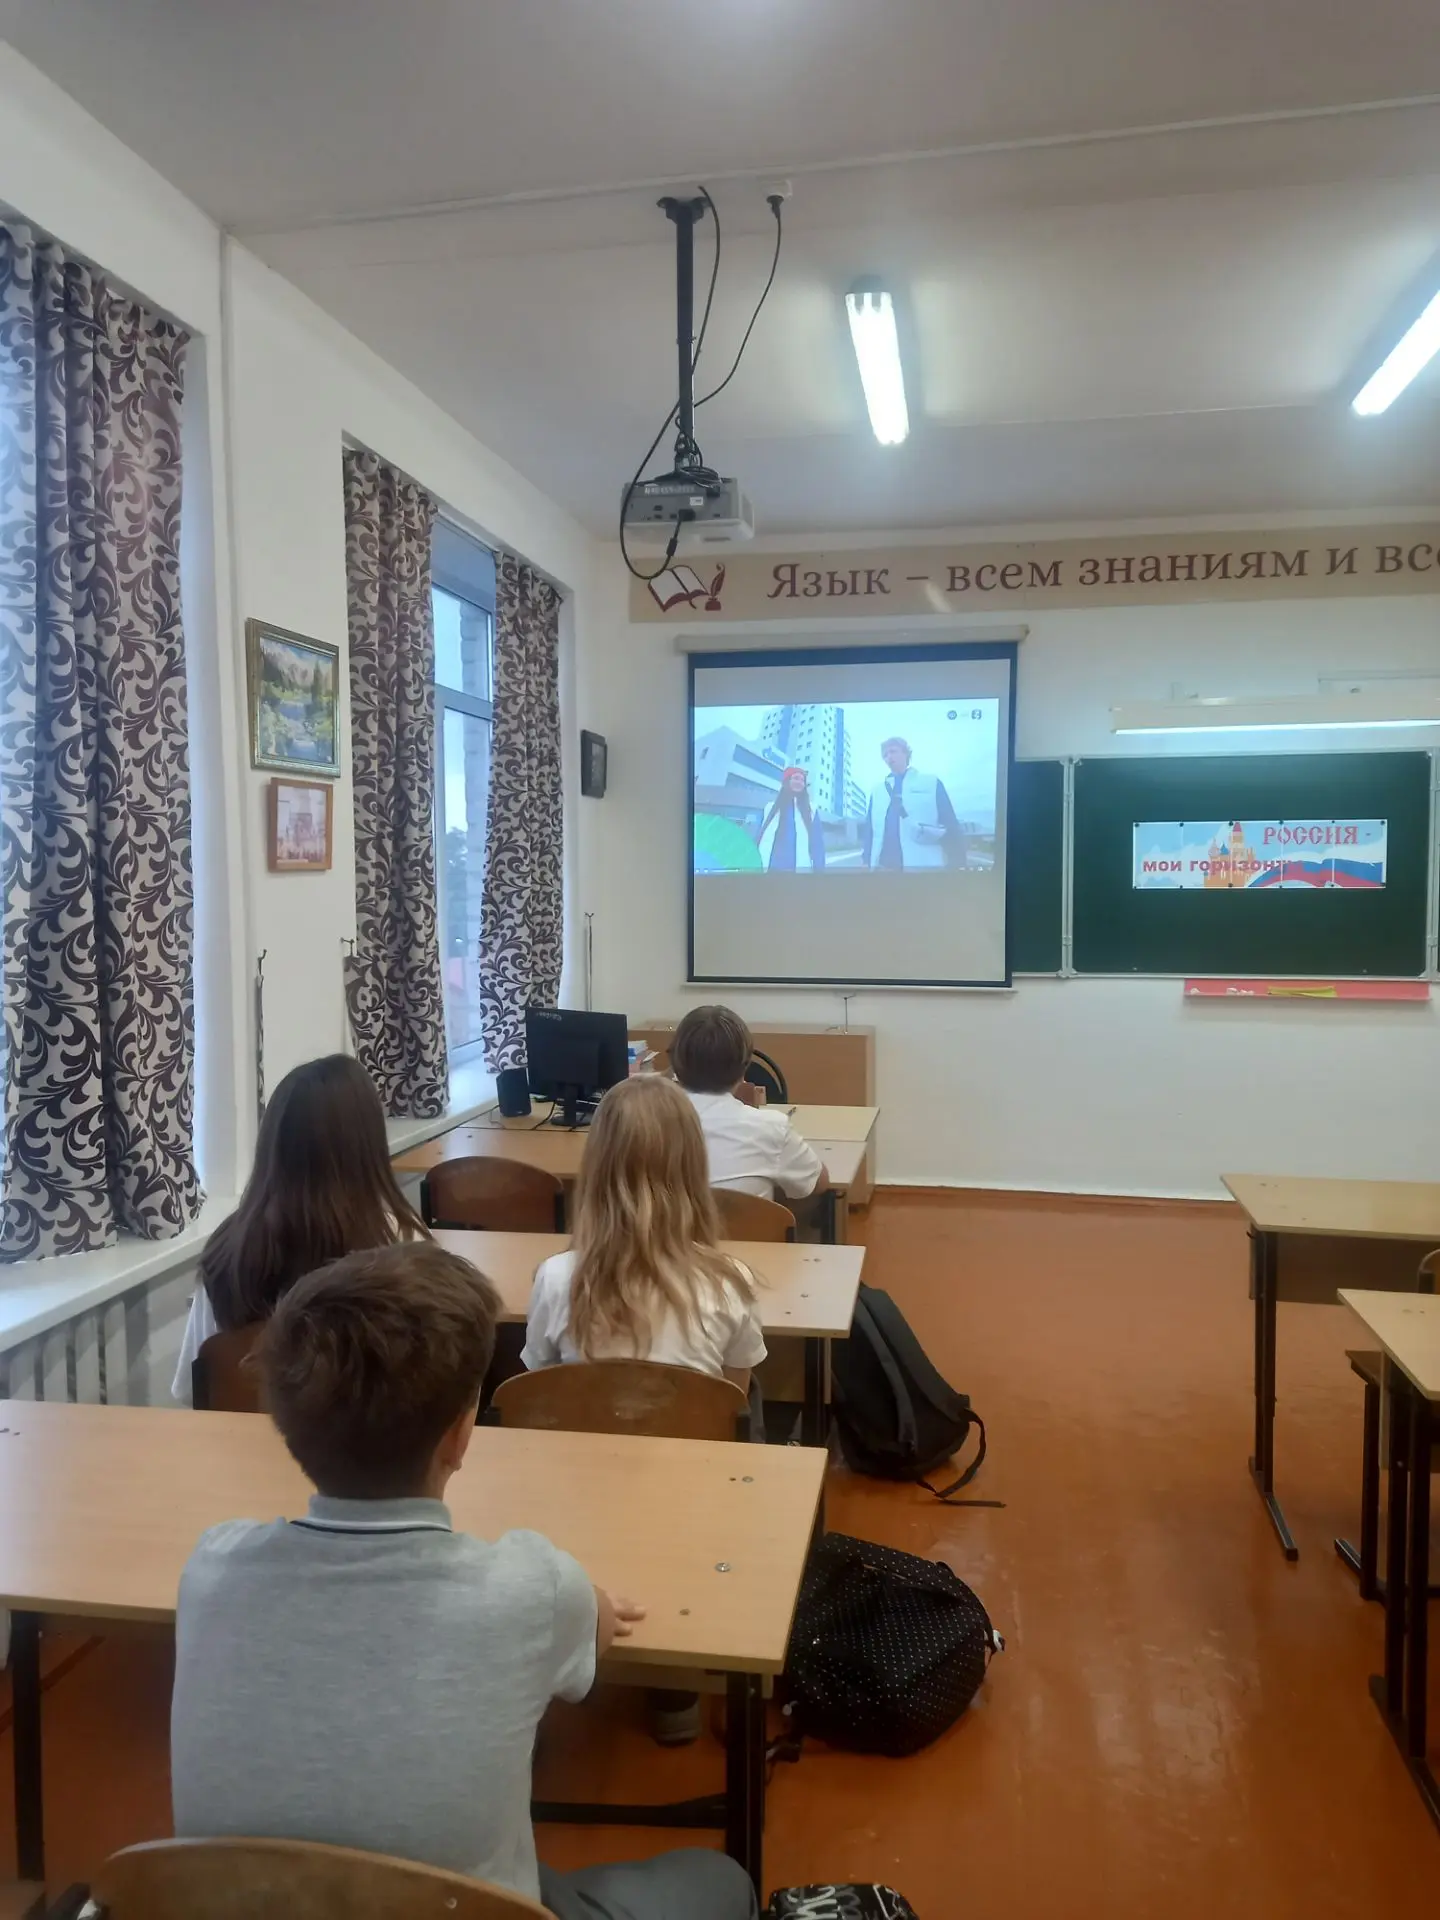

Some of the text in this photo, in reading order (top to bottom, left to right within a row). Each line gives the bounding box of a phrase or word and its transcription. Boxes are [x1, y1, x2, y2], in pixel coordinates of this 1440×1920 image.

[767, 563, 891, 599] Язык
[946, 560, 1063, 592] всем
[1078, 549, 1309, 586] знаниям
[1325, 547, 1359, 575] и
[1375, 543, 1440, 574] вс
[1263, 825, 1359, 846] РОССИЯ
